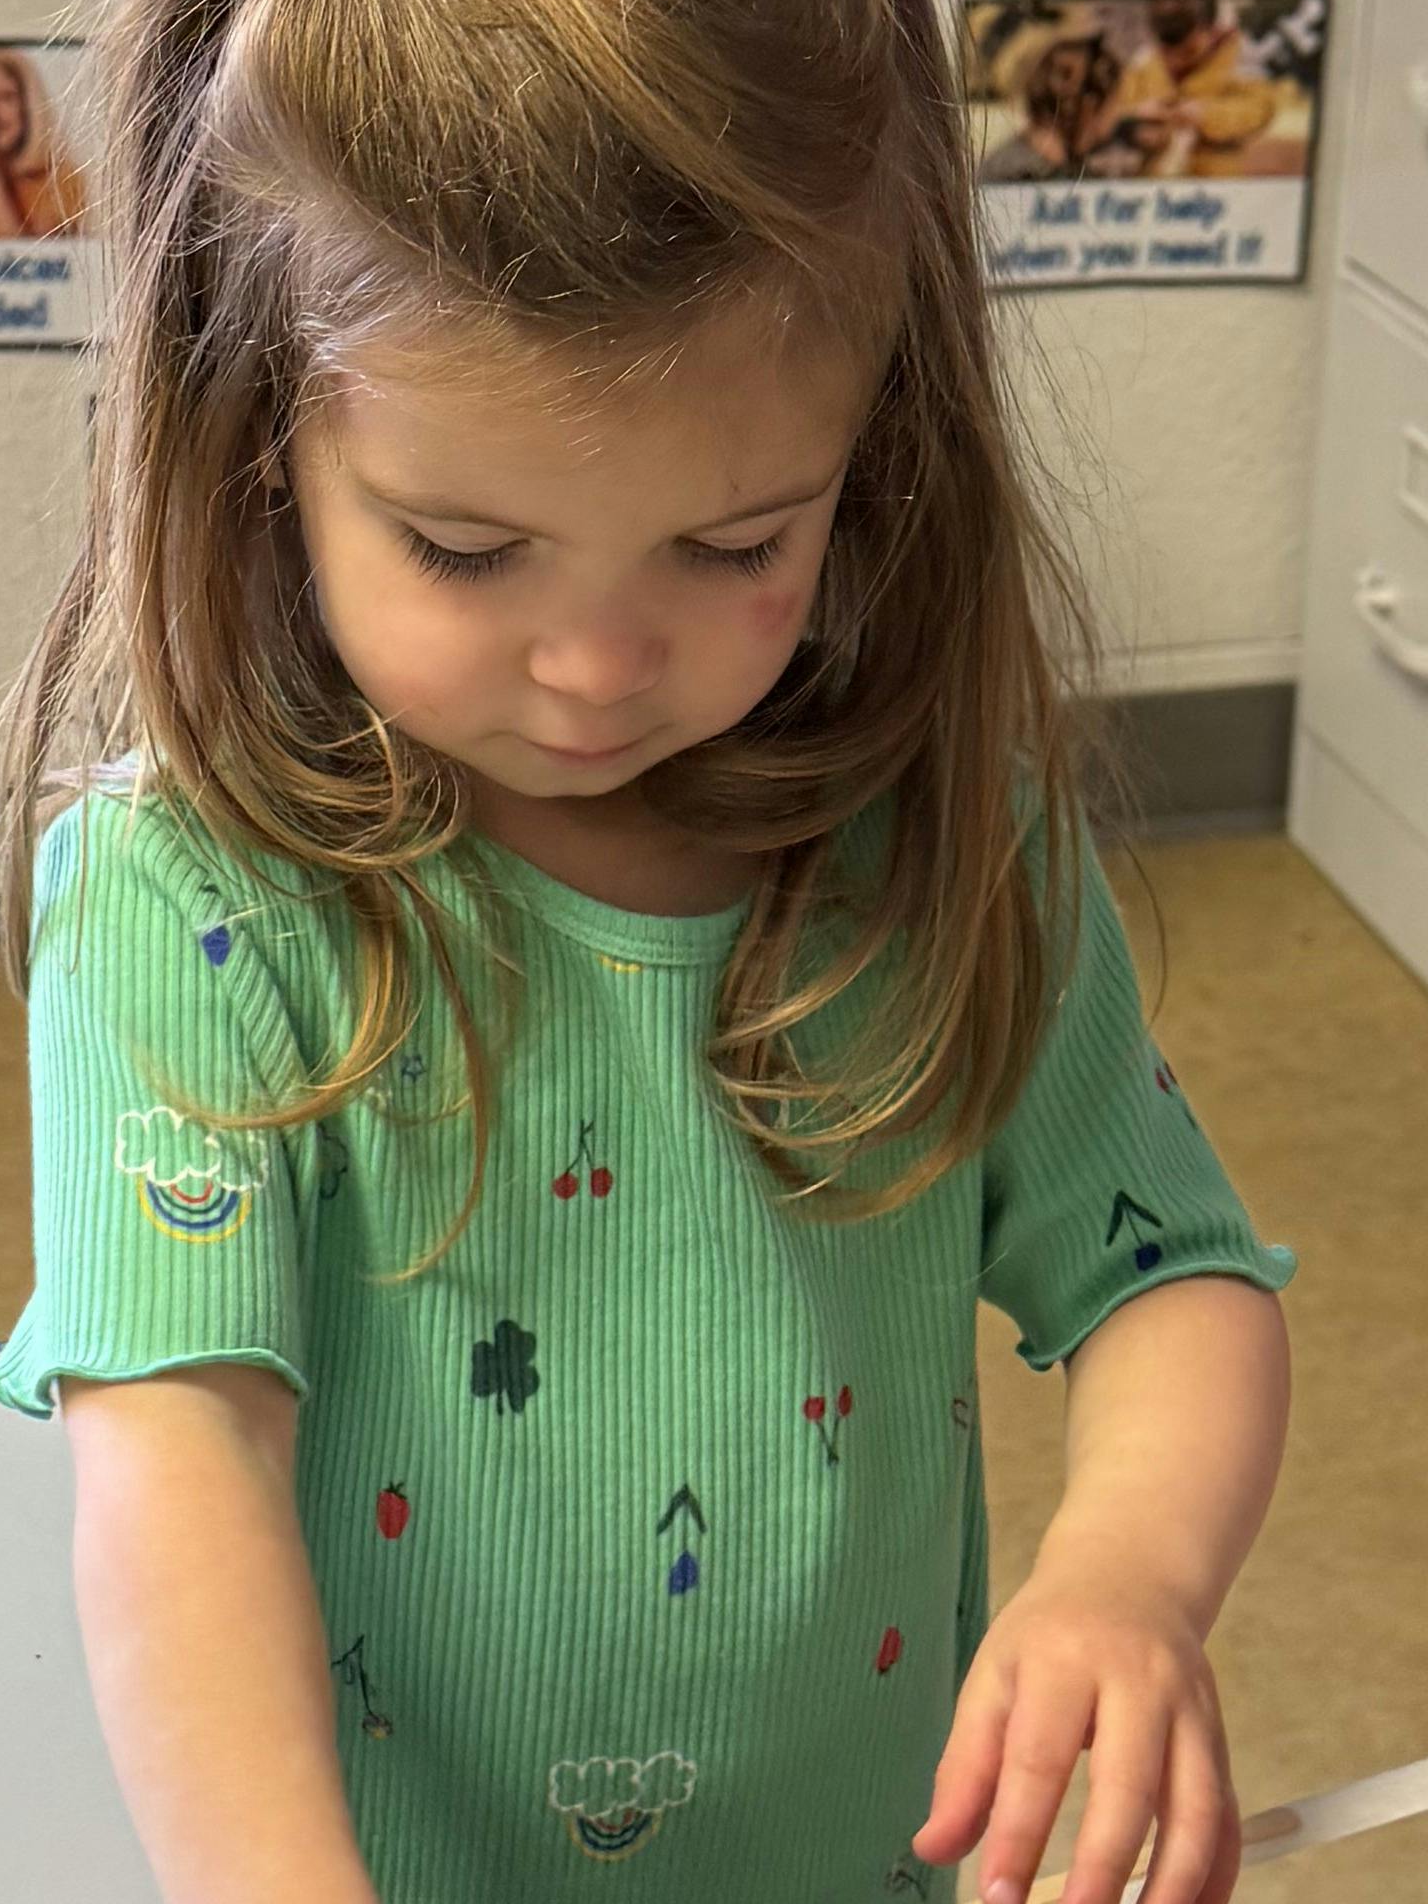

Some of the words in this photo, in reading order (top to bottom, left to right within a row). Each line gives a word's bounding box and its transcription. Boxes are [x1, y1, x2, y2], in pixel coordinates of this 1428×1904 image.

[1094, 188, 1143, 224] for
[1155, 188, 1224, 231] help
[1080, 242, 1136, 273] you
[1148, 231, 1225, 266] need
